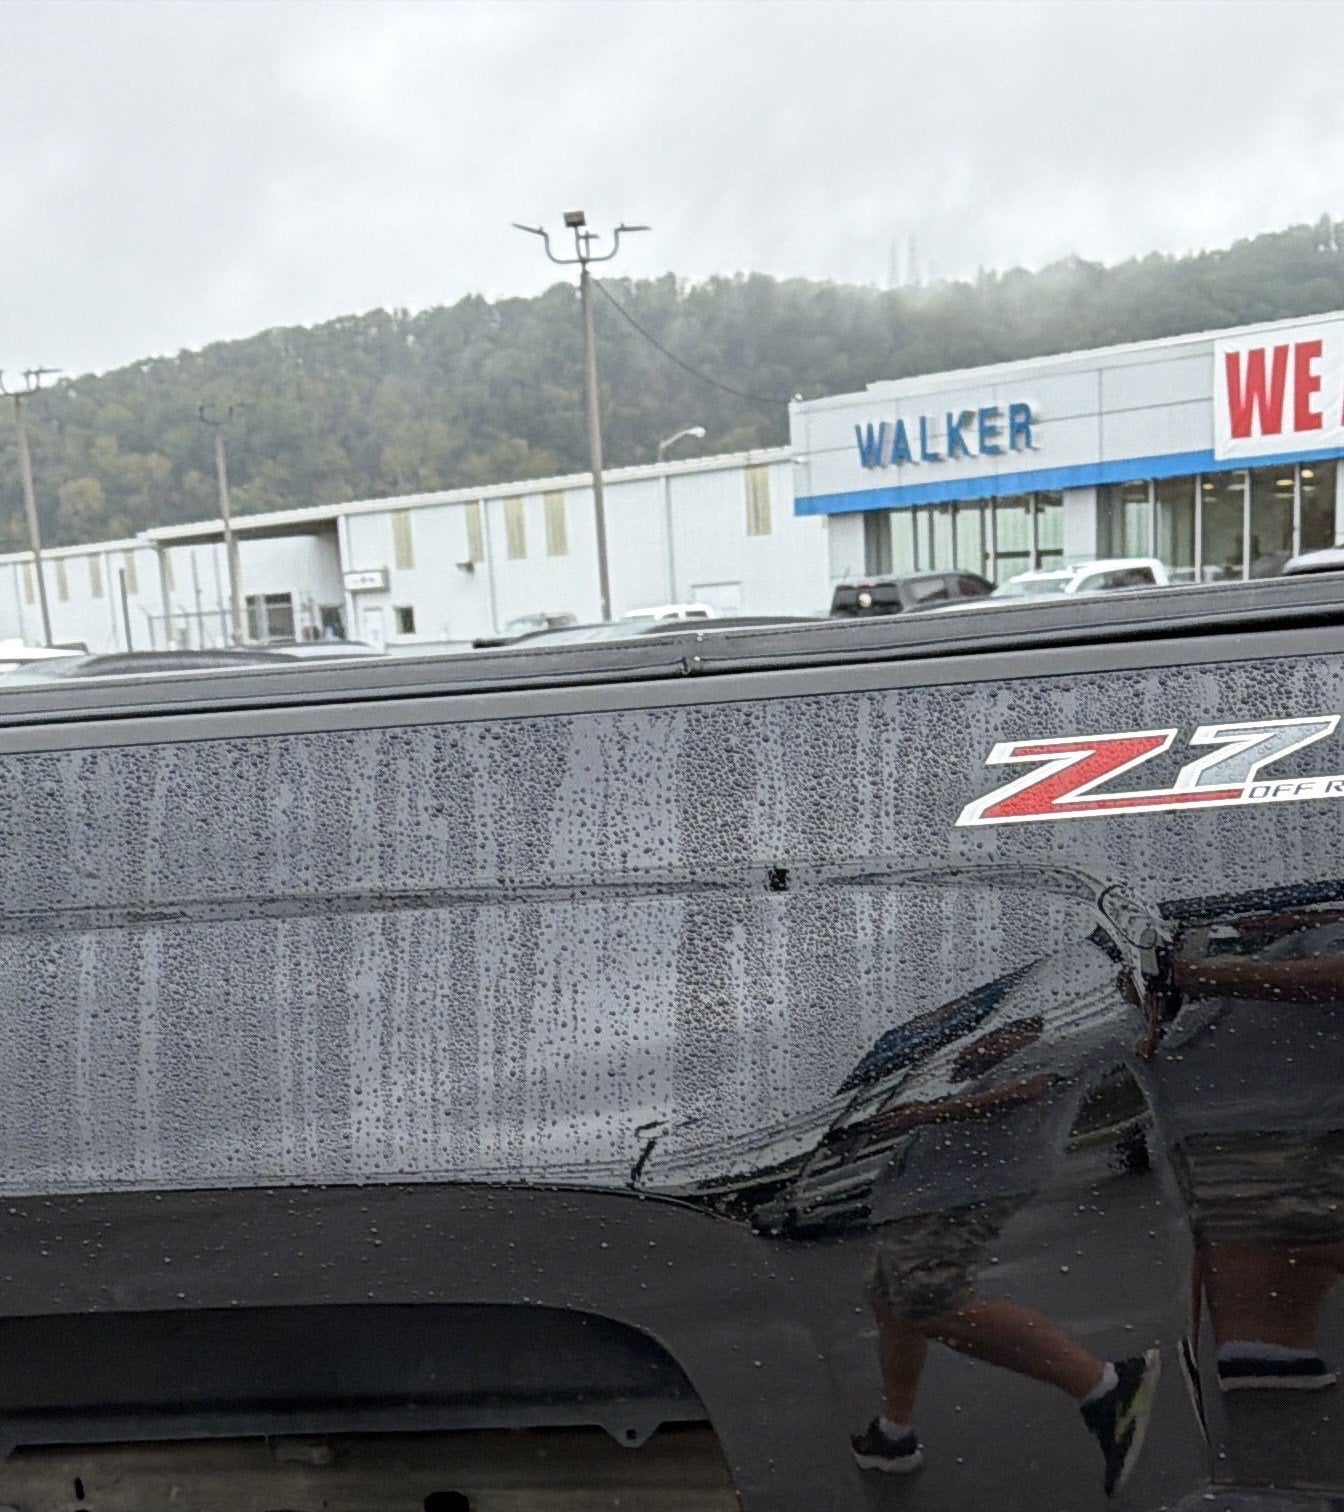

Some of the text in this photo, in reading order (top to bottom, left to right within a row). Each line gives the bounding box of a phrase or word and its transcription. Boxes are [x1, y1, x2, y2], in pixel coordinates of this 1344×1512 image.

[1225, 339, 1323, 440] WE
[854, 402, 1038, 469] WALKER
[1248, 781, 1317, 799] OFF
